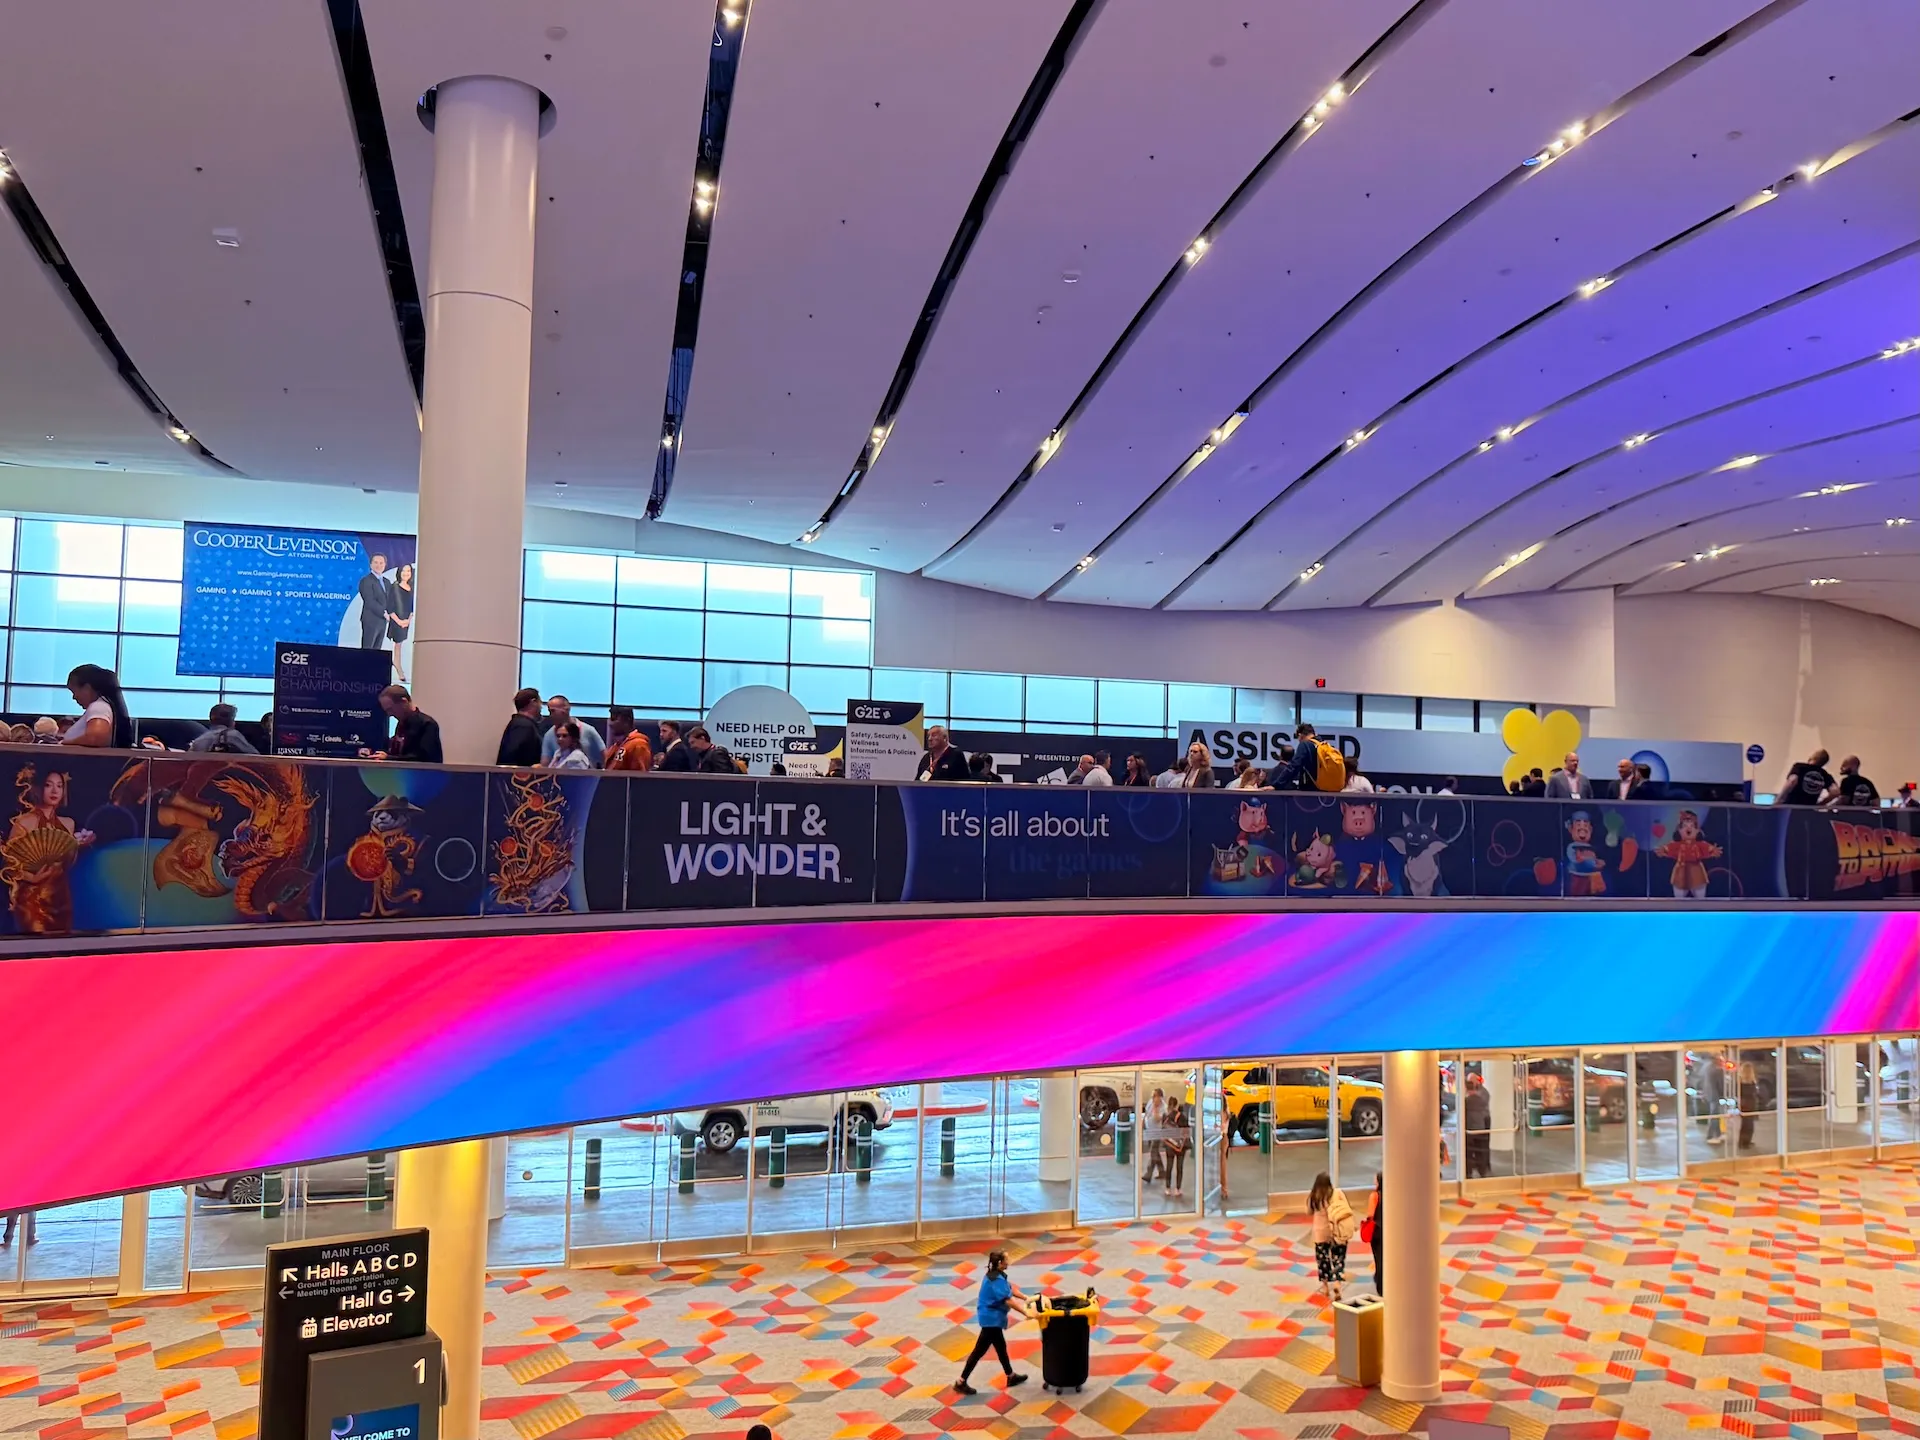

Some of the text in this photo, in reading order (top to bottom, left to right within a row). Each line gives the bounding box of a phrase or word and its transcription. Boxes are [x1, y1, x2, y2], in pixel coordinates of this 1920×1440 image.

[194, 530, 358, 556] COOPER LEVENSON
[288, 552, 329, 560] ATTORNEYS
[237, 570, 313, 579] www.GamingLawyers.com
[196, 586, 227, 595] GAMING
[284, 590, 311, 598] SPORTS
[312, 591, 351, 600] WAGERING
[281, 651, 309, 665] G2E
[280, 665, 331, 680] DEALER
[280, 678, 383, 695] CHAMPIONSHIP
[854, 705, 880, 719] G2E
[716, 722, 806, 735] NEED HELP OR
[850, 731, 873, 739] Safety,
[874, 732, 901, 740] Security,
[733, 737, 767, 748] NEED
[788, 740, 809, 751] G2E
[850, 747, 887, 755] Information
[893, 748, 917, 756] Policies
[1034, 753, 1071, 762] PRESENTED
[1072, 754, 1080, 762] BY
[680, 801, 827, 836] LIGHT &
[940, 808, 1110, 837] It's all about
[663, 843, 841, 884] WONDER
[1009, 844, 1143, 880] the games
[321, 1243, 390, 1260] MAIN FLOOR
[306, 1252, 418, 1281] Halls A B C D
[297, 1272, 385, 1290] Ground Transportation
[296, 1288, 329, 1298] Meeting
[329, 1285, 358, 1294] Rooms
[341, 1289, 393, 1311] Hall G
[322, 1311, 393, 1334] Elevator
[413, 1357, 426, 1384] 1
[396, 1427, 411, 1438] TO
